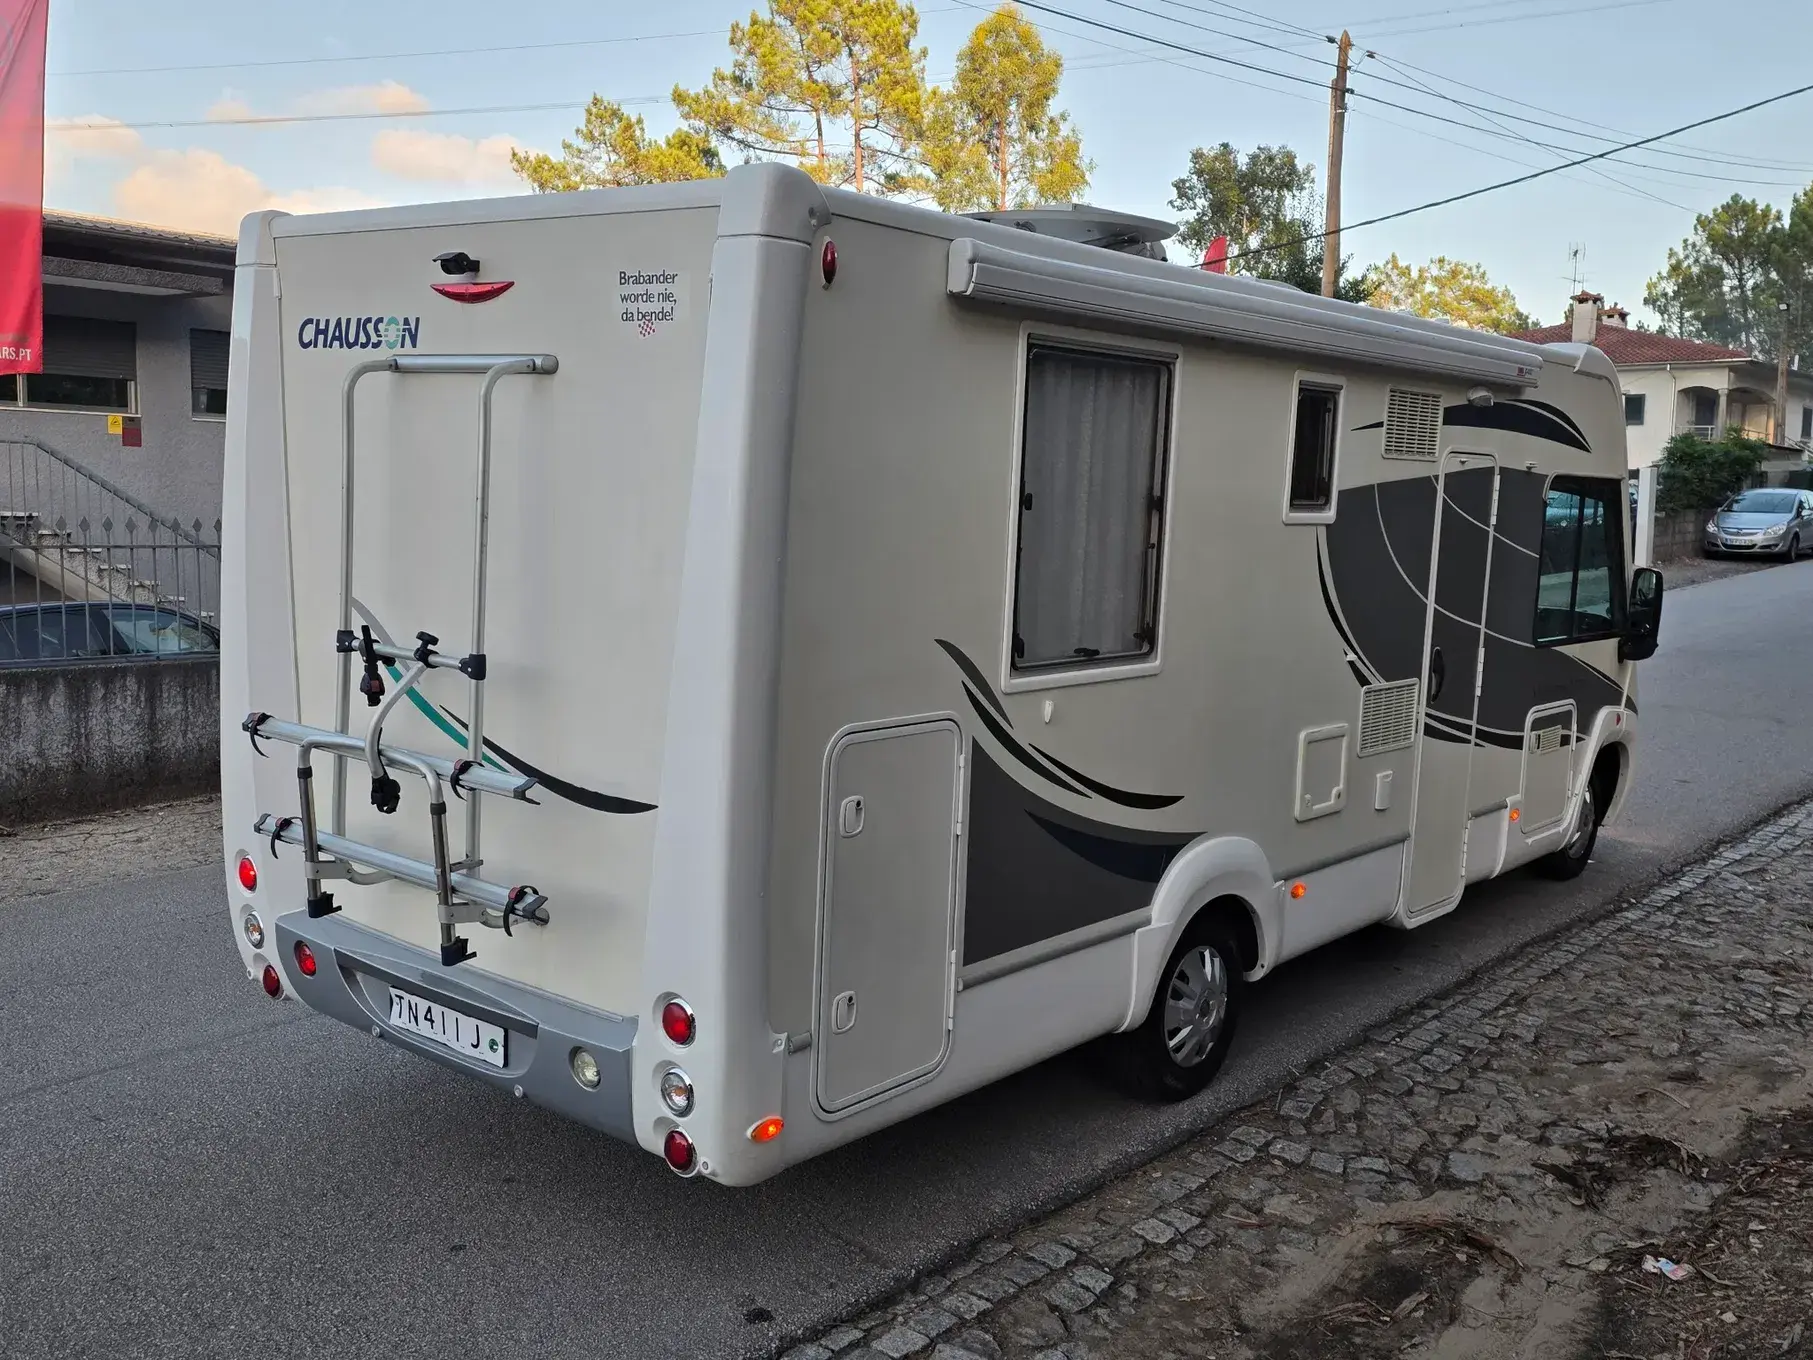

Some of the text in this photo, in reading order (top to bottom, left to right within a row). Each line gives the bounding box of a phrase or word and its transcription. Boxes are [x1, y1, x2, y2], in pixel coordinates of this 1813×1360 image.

[619, 269, 678, 286] Brabander
[620, 288, 677, 306] worde nie,
[621, 306, 674, 322] da bende!
[298, 316, 420, 350] CHAUSSON
[0, 346, 31, 361] RS.PT
